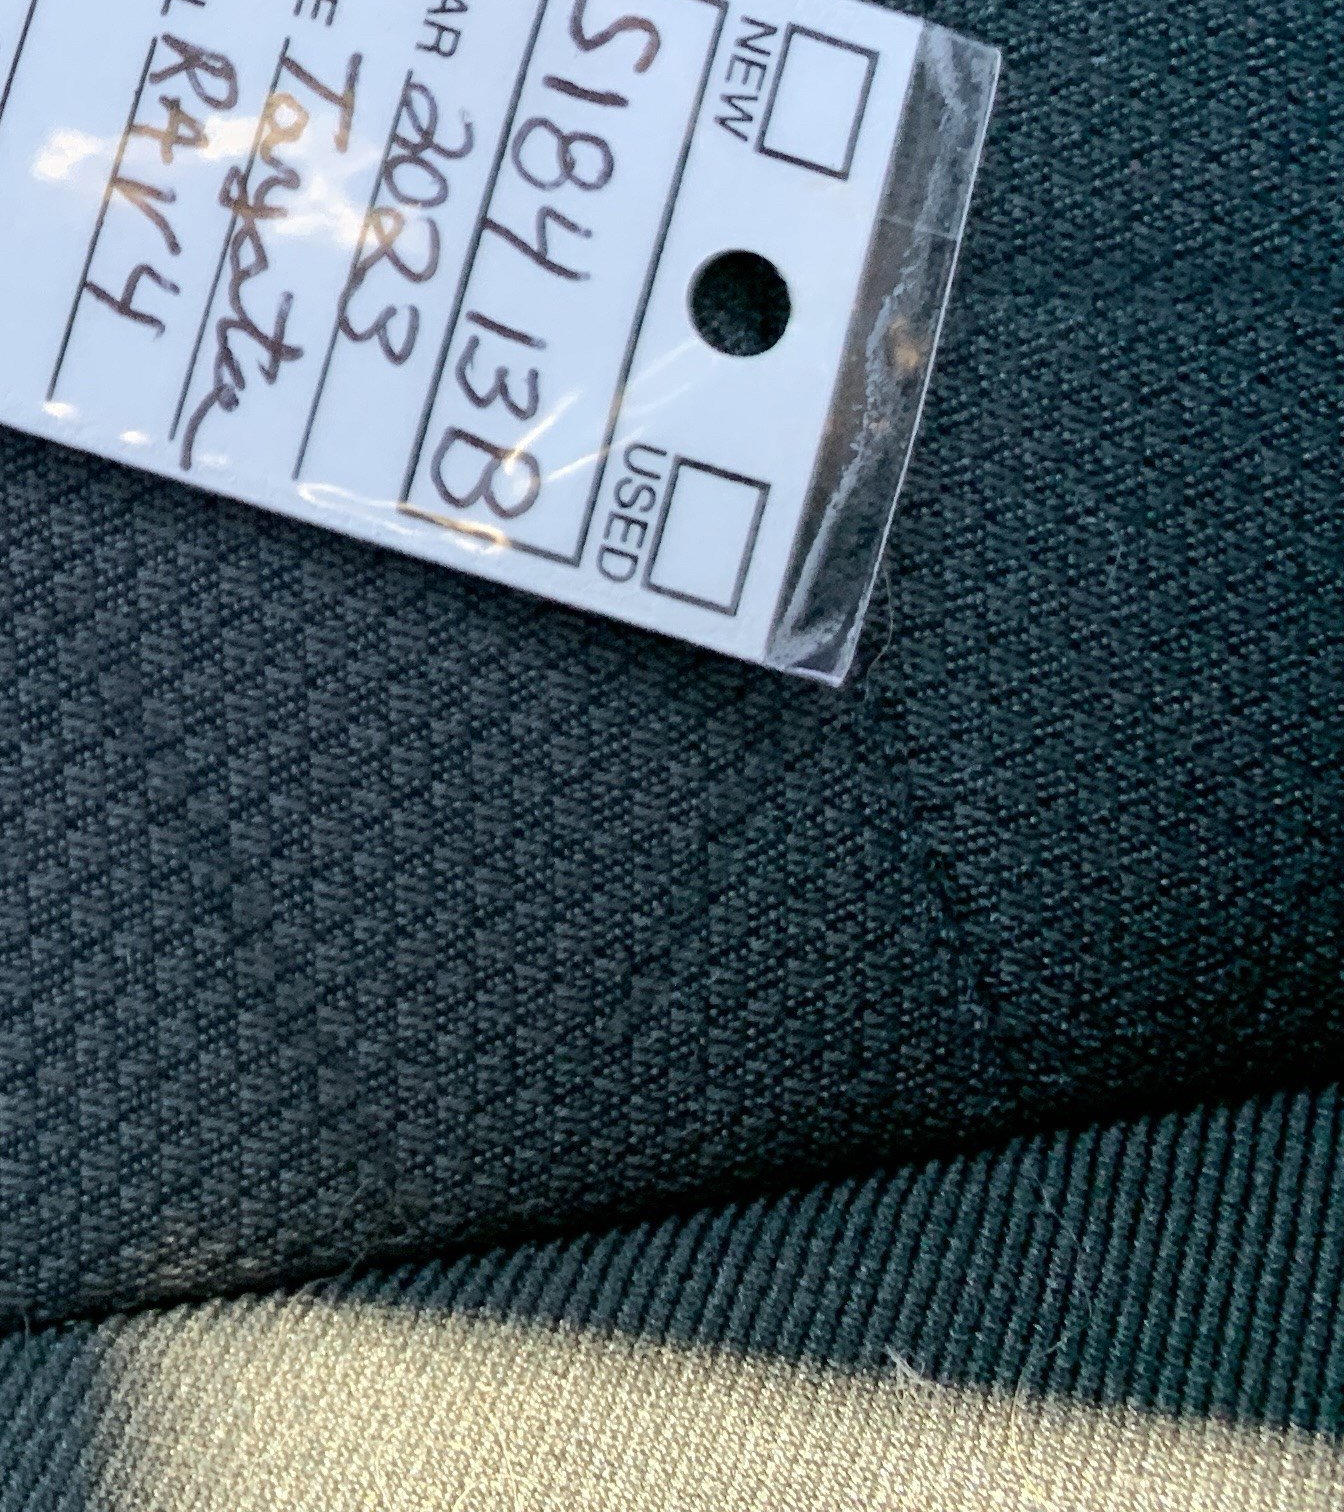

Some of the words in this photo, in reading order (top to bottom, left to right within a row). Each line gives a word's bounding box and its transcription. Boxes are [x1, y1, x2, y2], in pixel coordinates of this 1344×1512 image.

[714, 14, 779, 142] NEW
[338, 79, 475, 366] 2023
[596, 441, 669, 585] USED
